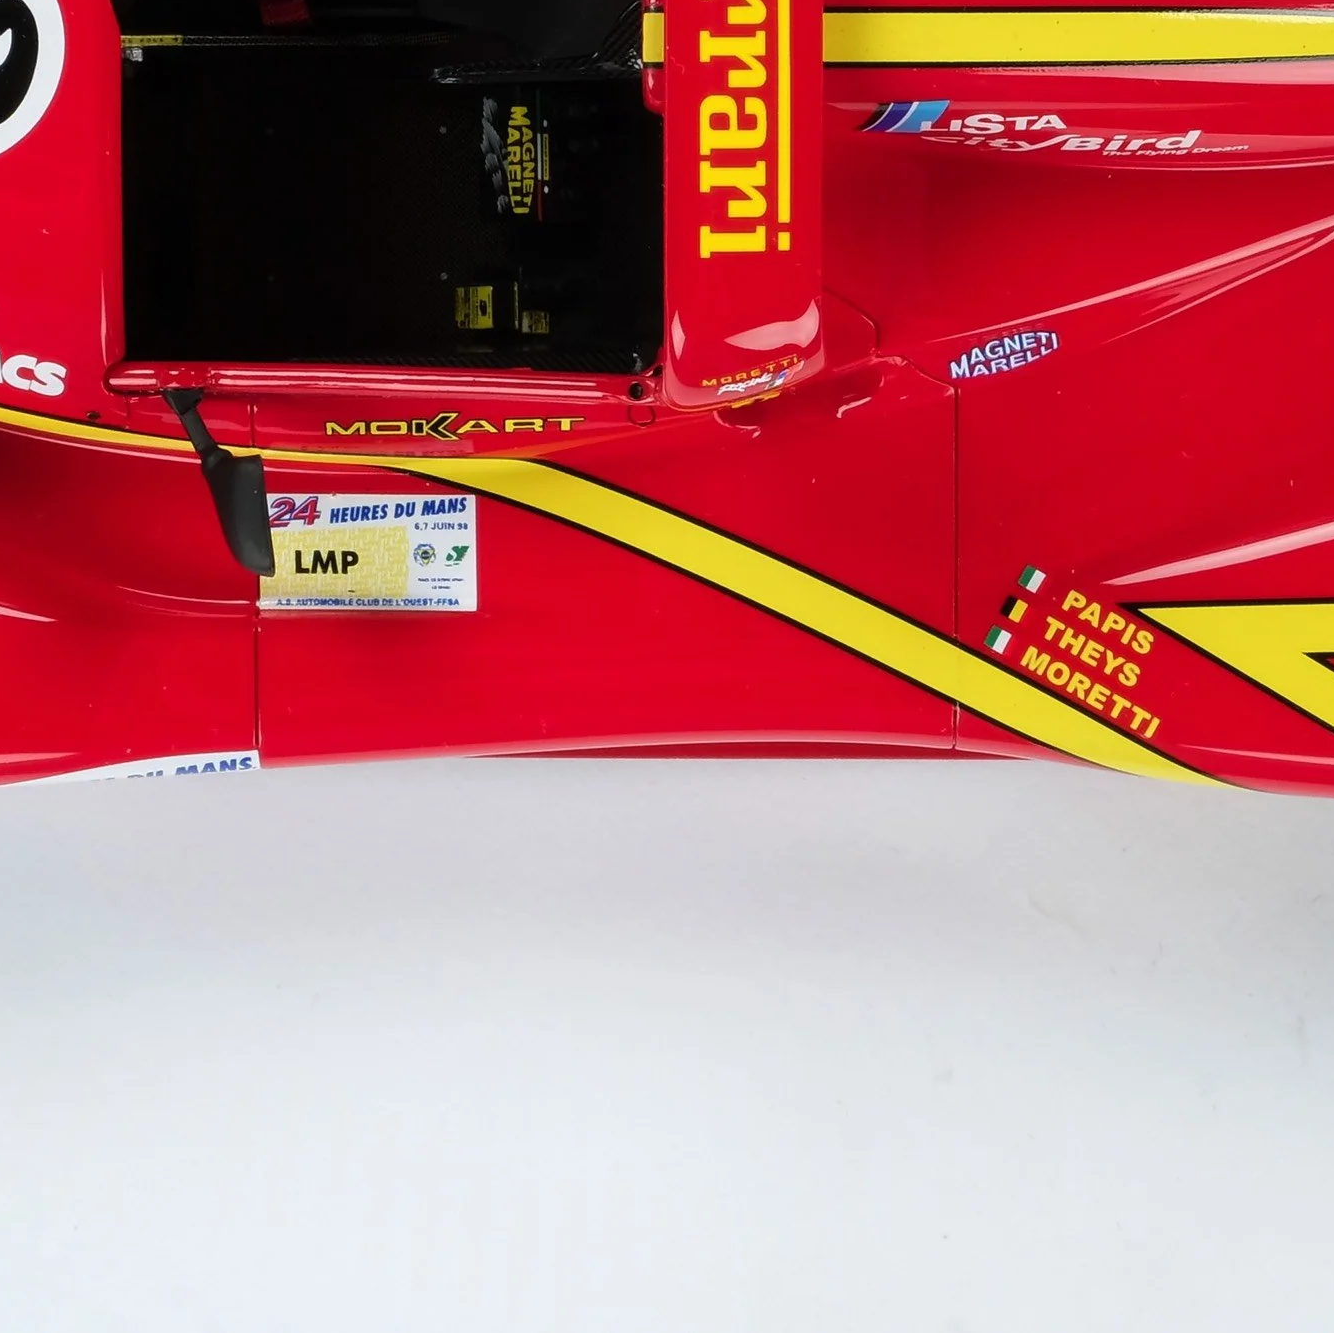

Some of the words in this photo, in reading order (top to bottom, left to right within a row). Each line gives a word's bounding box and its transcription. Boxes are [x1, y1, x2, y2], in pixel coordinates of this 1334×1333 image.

[919, 112, 1068, 135] LISTA
[506, 106, 526, 216] MARELLI
[513, 106, 536, 216] MAGNETI
[950, 331, 1059, 371] MAGNETI
[950, 345, 1059, 380] MARELLI
[701, 356, 799, 387] MORETTI
[325, 411, 585, 442] MOKART
[269, 495, 321, 528] 24
[329, 503, 389, 524] HEURES
[394, 501, 416, 518] DU
[420, 496, 468, 517] MANS
[431, 522, 455, 531] JUIN
[457, 522, 469, 531] 98
[295, 550, 359, 575] LMP
[296, 598, 354, 607] AUTOMOBILE
[355, 598, 380, 607] CLUB
[381, 598, 394, 607] DE
[1061, 589, 1155, 655] PAPIS
[1044, 616, 1141, 687] THEYS
[1020, 645, 1161, 739] MORETTI
